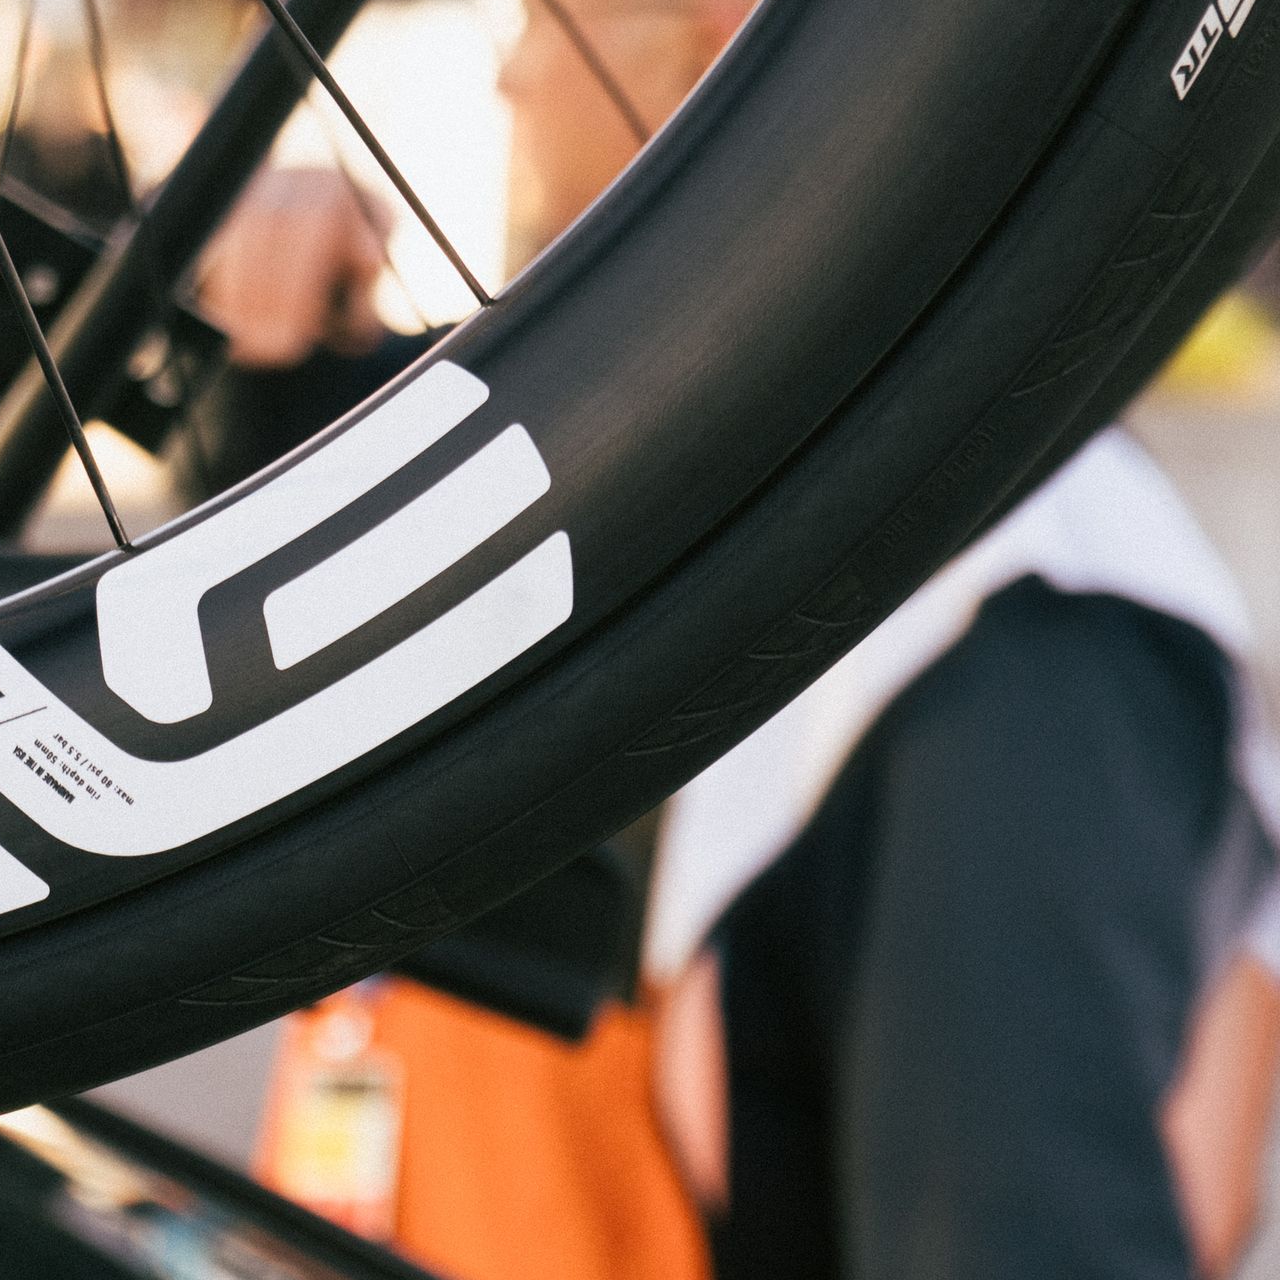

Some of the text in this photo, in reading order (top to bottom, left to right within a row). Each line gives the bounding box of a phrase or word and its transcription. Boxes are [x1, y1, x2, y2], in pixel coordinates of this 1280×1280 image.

[1175, 20, 1222, 93] TR
[52, 733, 69, 749] bar
[66, 745, 82, 761] 5.5
[12, 745, 76, 804] HANDMADE IN THE USA
[33, 738, 101, 800] rim depth: 50mm
[86, 763, 104, 778] psi
[113, 784, 134, 806] max:
